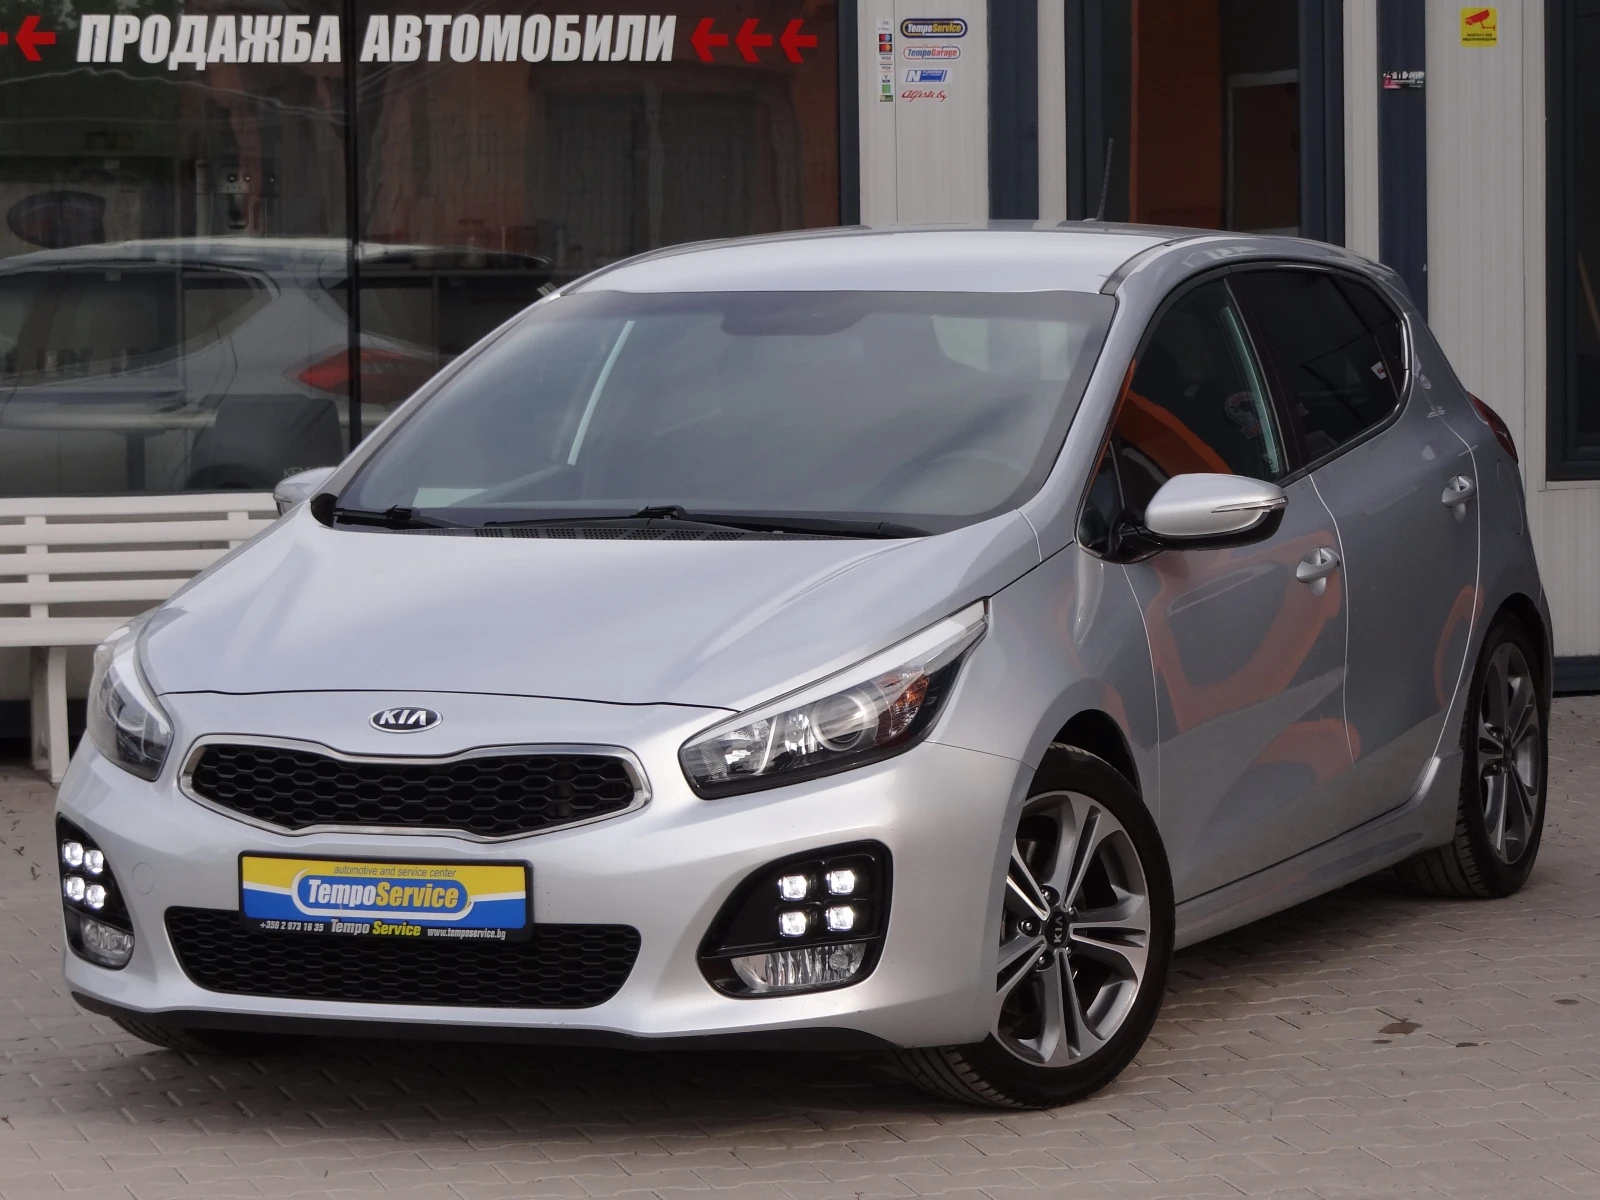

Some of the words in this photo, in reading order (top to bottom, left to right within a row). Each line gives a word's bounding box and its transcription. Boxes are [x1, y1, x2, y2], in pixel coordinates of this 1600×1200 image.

[907, 23, 962, 36] TempoService
[76, 14, 342, 71] ПРОДАЖБА
[359, 13, 677, 63] АВТОМОБИЛИ
[907, 48, 958, 60] TempoGarage
[379, 709, 427, 726] KIA
[333, 866, 378, 875] automotive
[379, 867, 395, 876] and
[397, 867, 427, 877] service
[429, 868, 456, 877] center
[308, 879, 459, 908] TempoService
[260, 920, 280, 930] +359
[281, 921, 286, 930] 2
[287, 922, 301, 931] 973
[303, 923, 313, 932] 16
[314, 923, 324, 932] 35
[331, 919, 370, 935] Tempo
[372, 921, 421, 936] Service
[427, 928, 506, 940] www.temposervice.bg
[1054, 916, 1062, 942] KIA
